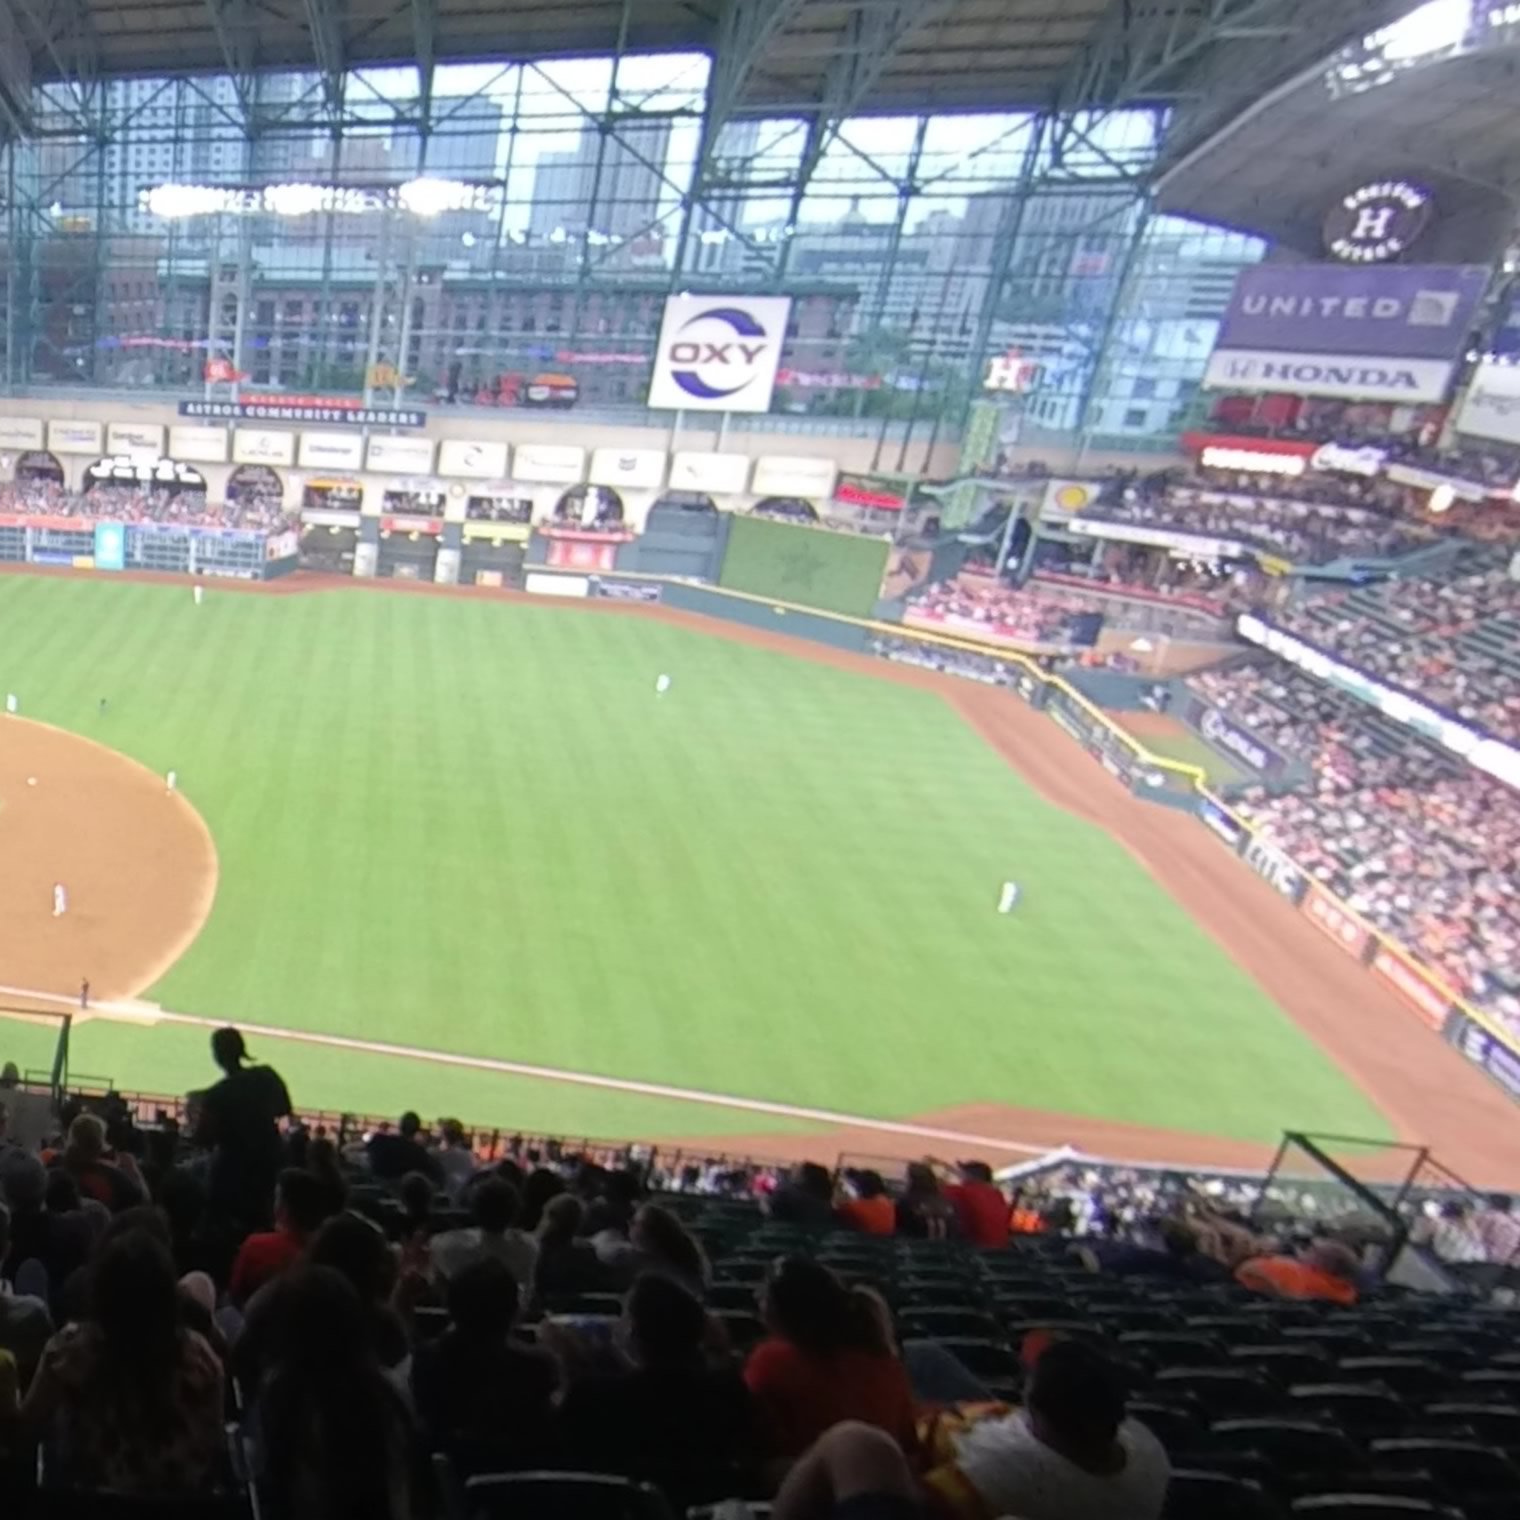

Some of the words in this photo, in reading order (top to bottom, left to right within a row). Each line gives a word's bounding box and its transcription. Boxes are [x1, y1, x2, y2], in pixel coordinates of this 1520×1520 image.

[1351, 206, 1394, 238] H
[1242, 295, 1402, 318] UNITED
[668, 342, 768, 365] OXY
[983, 357, 1022, 389] H
[1262, 361, 1420, 390] HONDA
[186, 402, 242, 416] ASTROS
[245, 405, 341, 421] COMMUNITY
[347, 410, 419, 425] LEADERS
